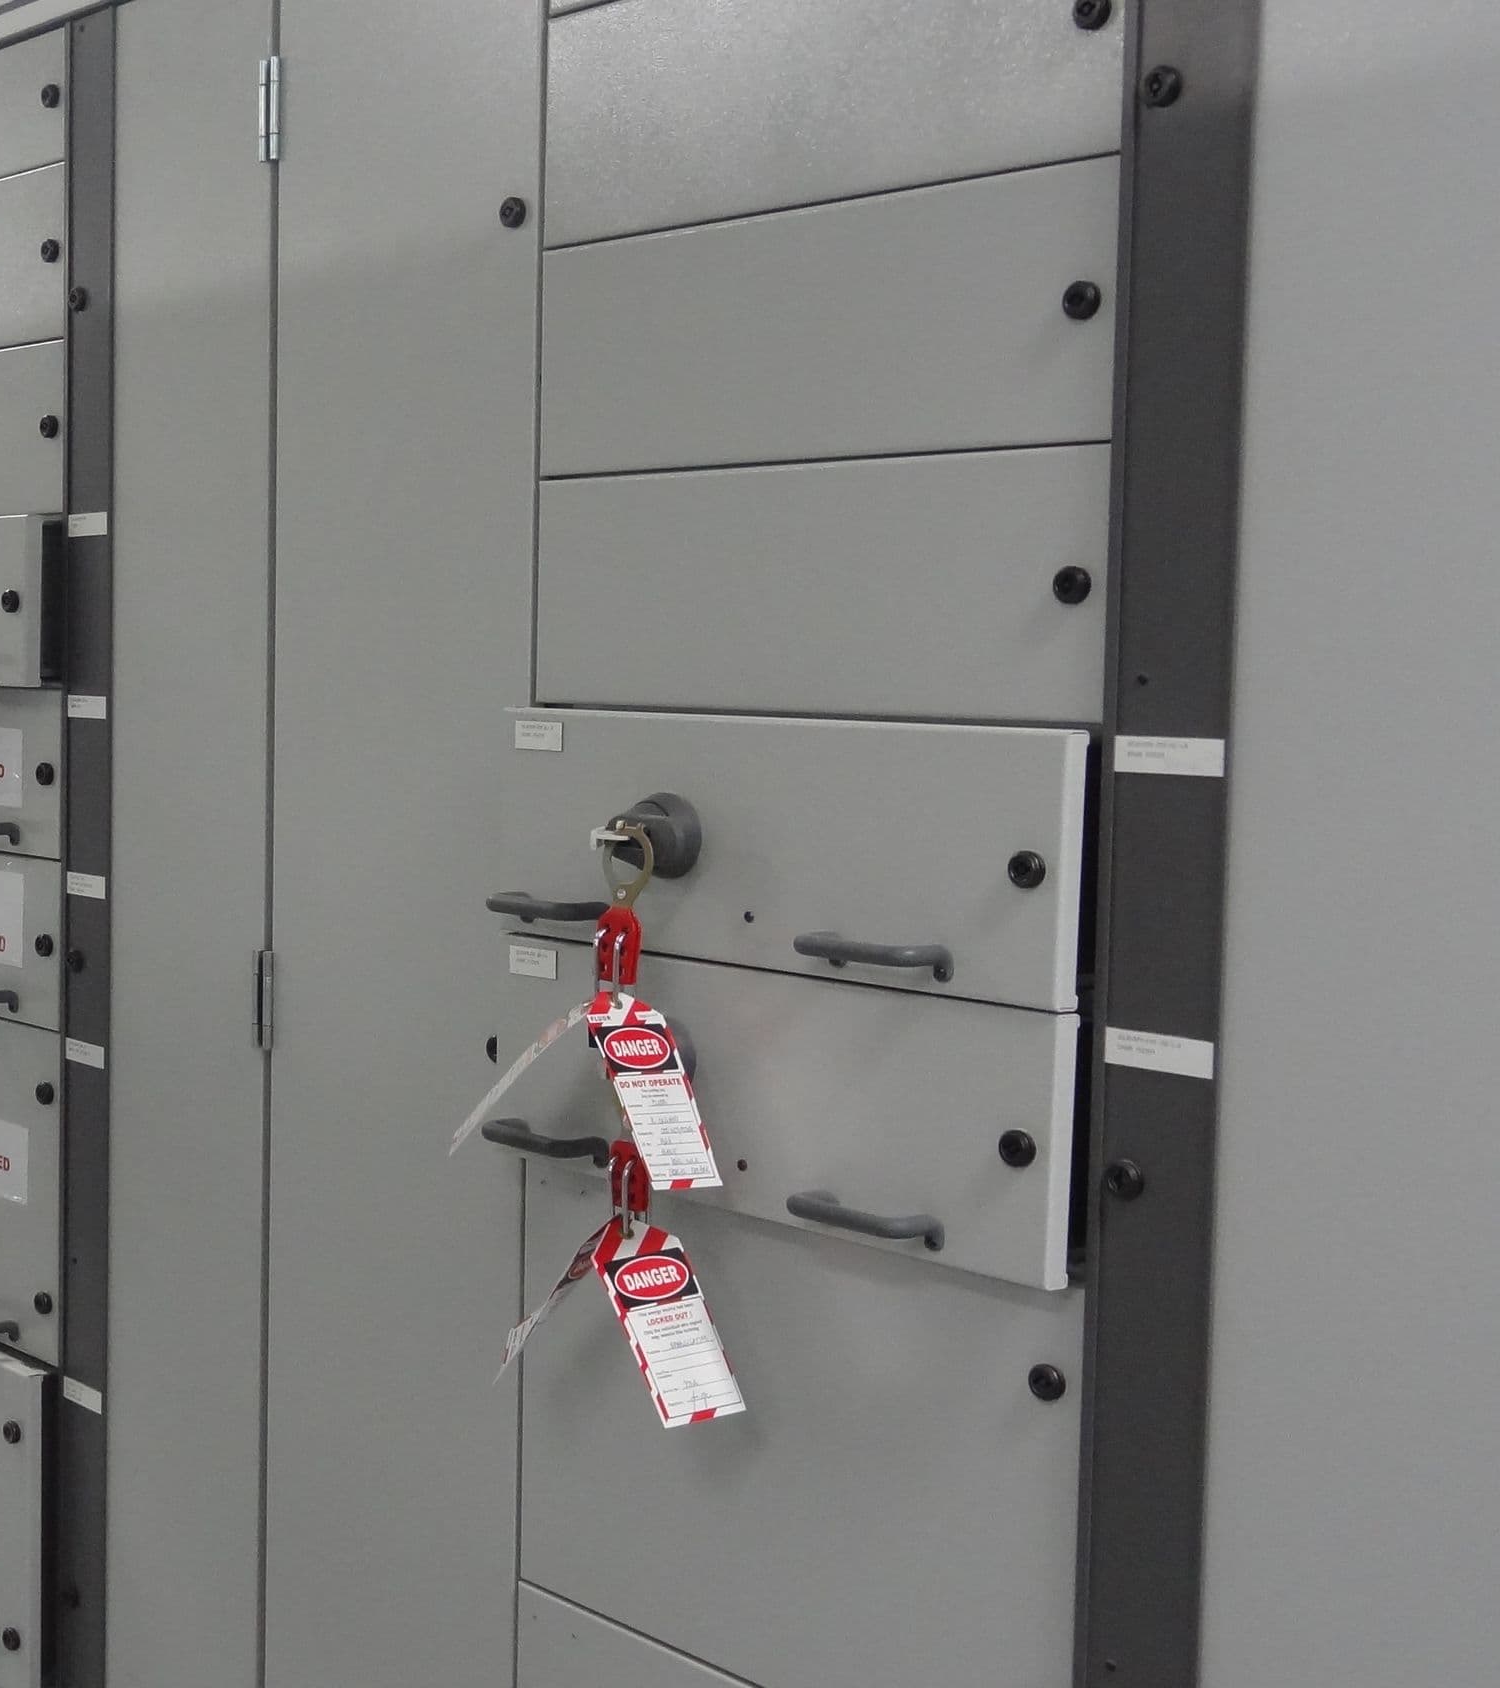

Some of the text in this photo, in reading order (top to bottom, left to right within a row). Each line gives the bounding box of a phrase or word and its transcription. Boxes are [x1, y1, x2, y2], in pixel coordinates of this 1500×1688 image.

[611, 1038, 663, 1057] DANGER
[619, 1078, 682, 1089] DO NOT OPERATE
[622, 1265, 681, 1291] DANGER
[646, 1315, 674, 1326] LOCKED
[675, 1311, 689, 1321] OUT
